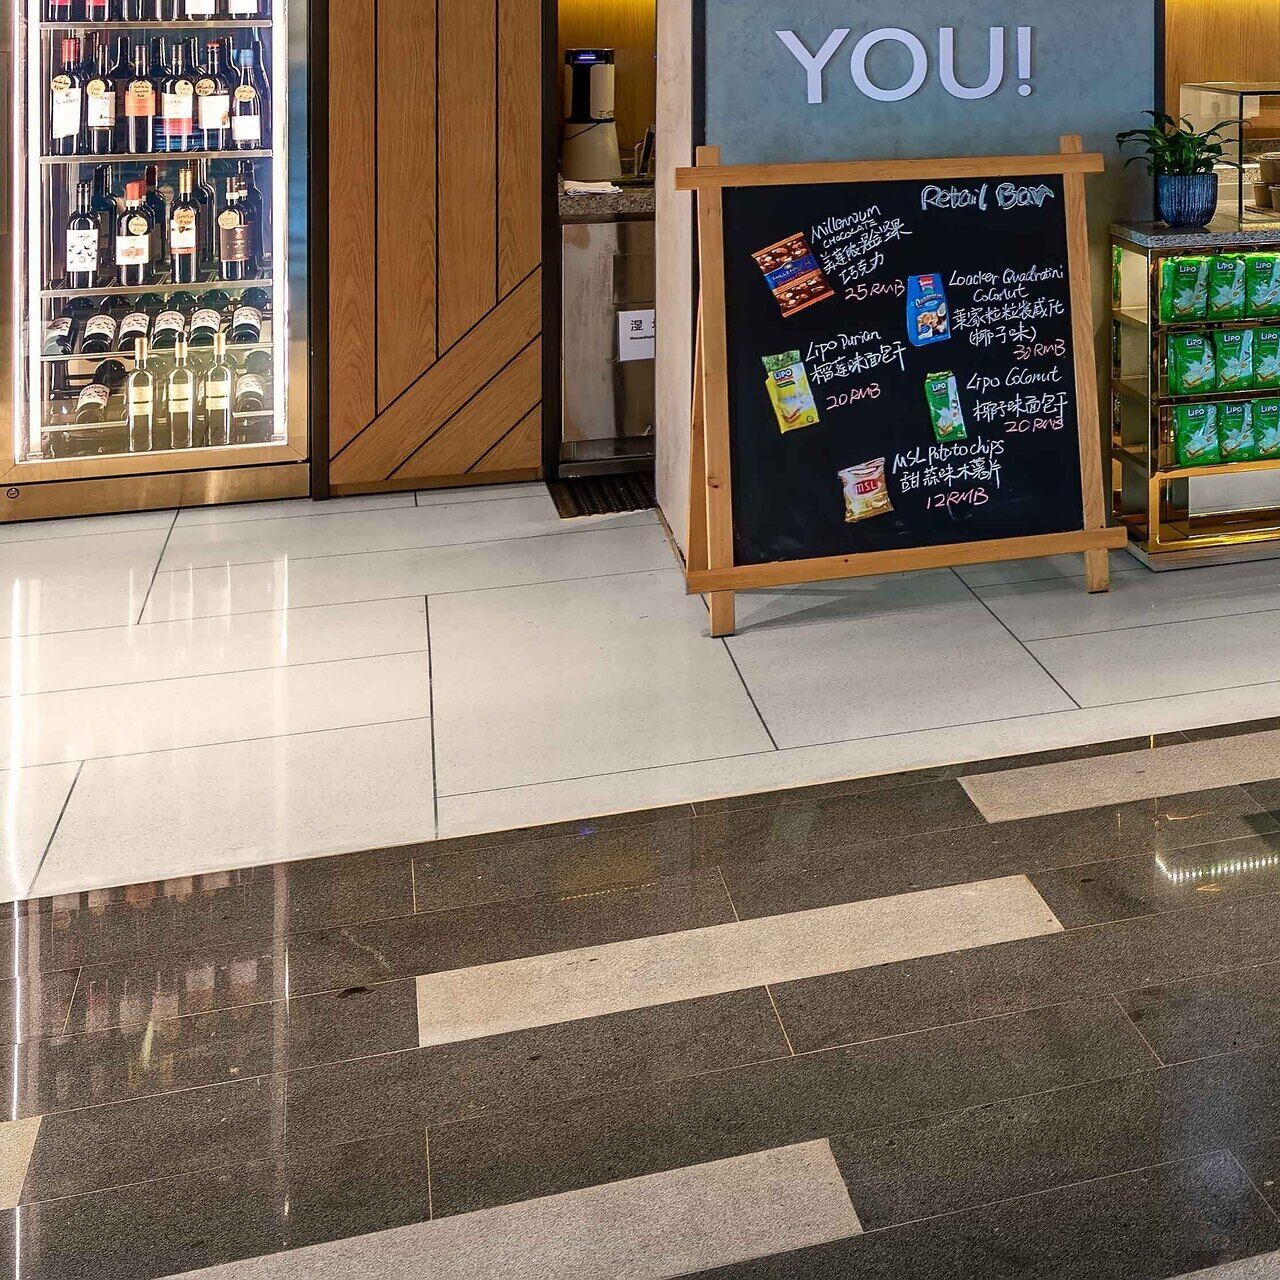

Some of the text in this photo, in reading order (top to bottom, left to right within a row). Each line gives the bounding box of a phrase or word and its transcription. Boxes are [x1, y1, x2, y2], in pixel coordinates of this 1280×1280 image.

[774, 26, 1034, 105] YOU!
[920, 182, 1055, 211] Retail Bar
[838, 251, 885, 285] 巧克力
[948, 270, 1000, 286] Loacker
[854, 479, 879, 495] MSL
